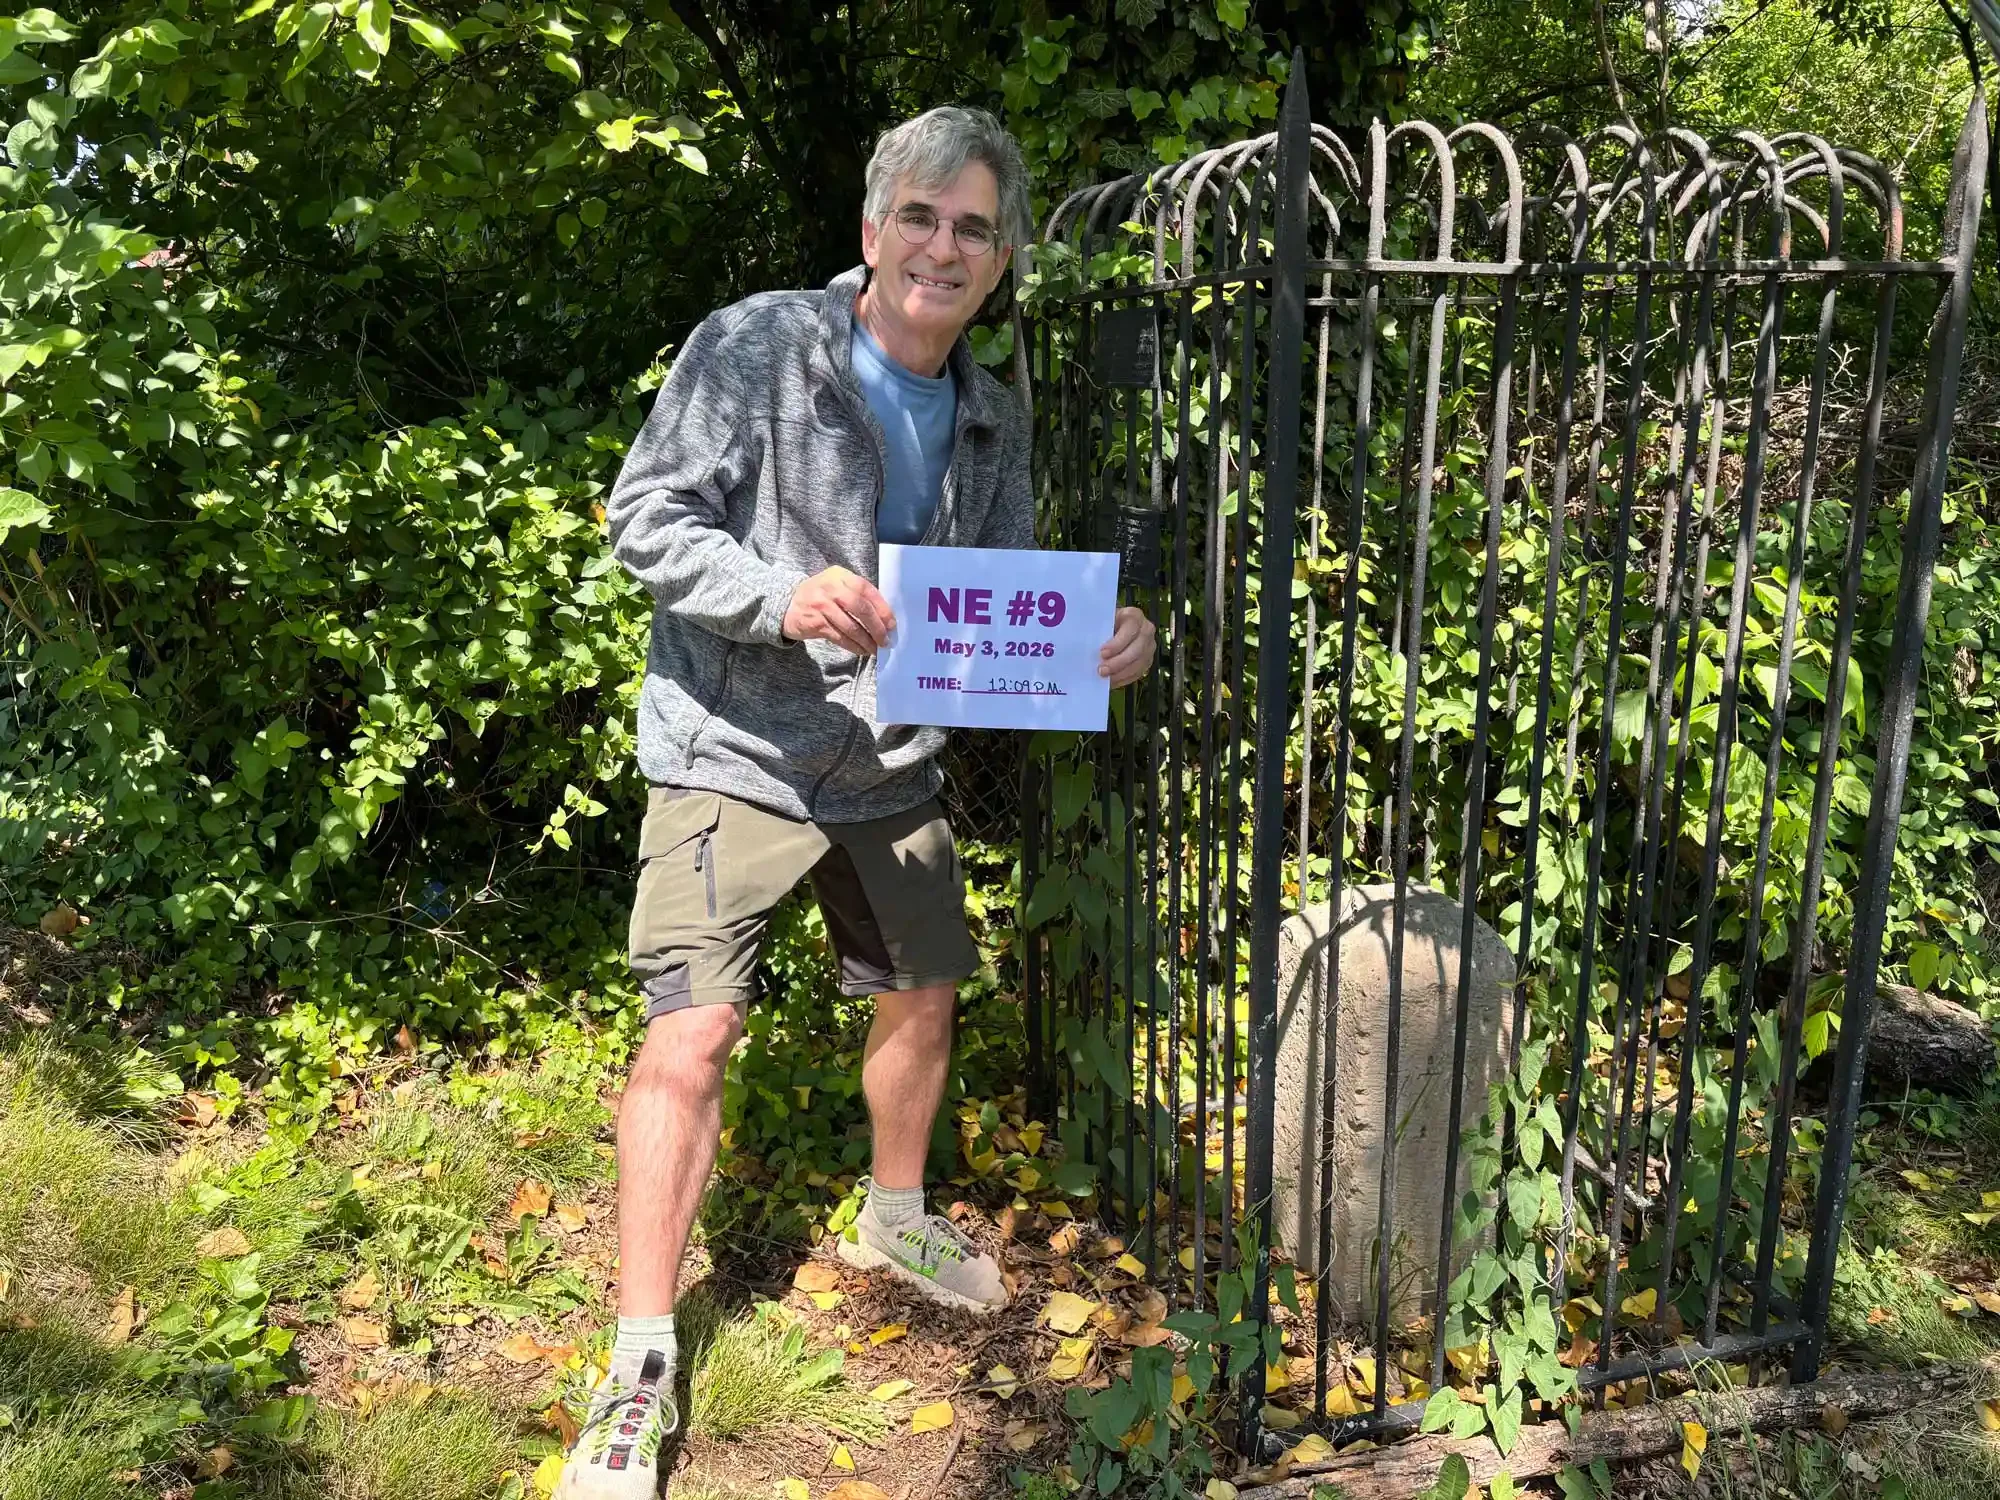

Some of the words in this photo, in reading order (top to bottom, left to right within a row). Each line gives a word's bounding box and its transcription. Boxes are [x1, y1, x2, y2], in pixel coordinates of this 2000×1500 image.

[928, 587, 992, 625] NE
[1006, 590, 1066, 627] #9
[934, 638, 976, 657] May
[981, 640, 999, 659] 3,
[1005, 641, 1055, 657] 2026
[917, 676, 962, 690] TIME:
[988, 677, 1030, 693] 12:09
